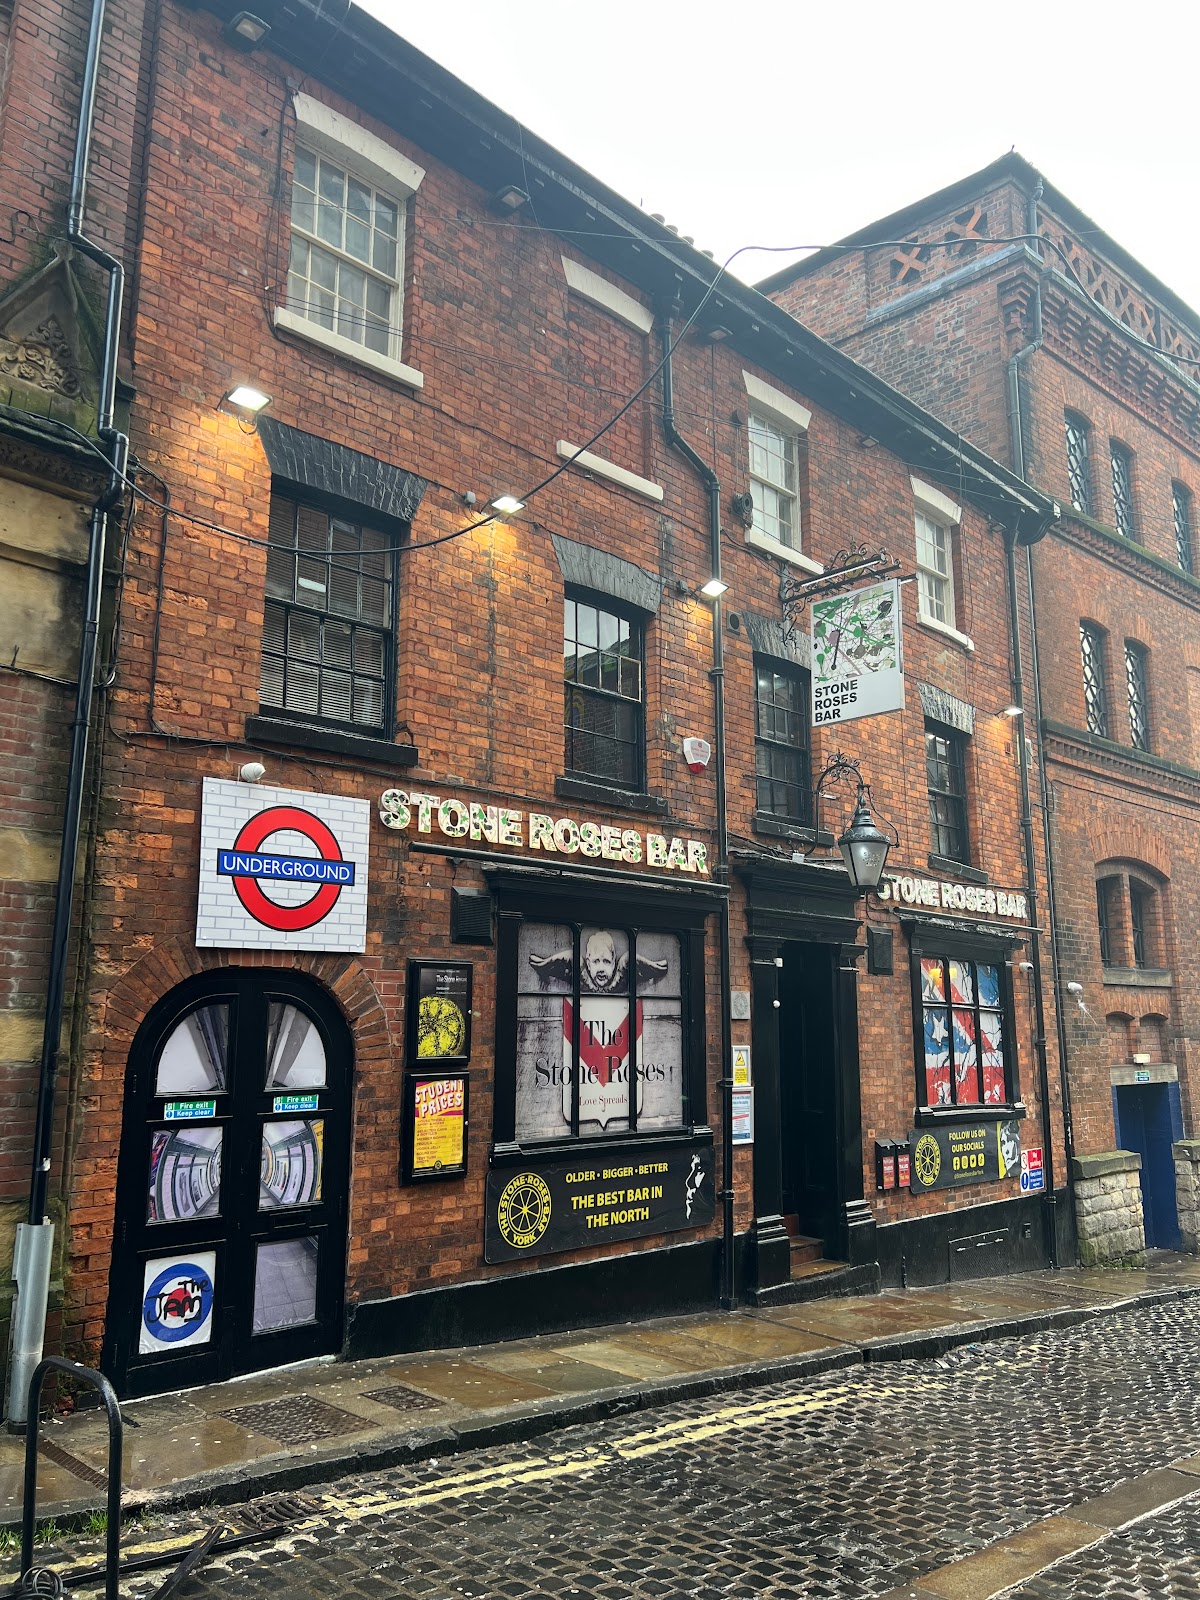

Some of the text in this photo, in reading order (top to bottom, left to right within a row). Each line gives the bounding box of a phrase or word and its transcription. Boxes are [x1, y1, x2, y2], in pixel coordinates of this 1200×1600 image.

[814, 679, 858, 698] STONE
[814, 692, 858, 711] ROSES
[814, 708, 841, 723] BAR
[379, 788, 709, 874] STONE ROSES BAR
[223, 855, 350, 881] UNDERGROUND
[877, 872, 1028, 919] STONE ROSES BAR
[583, 1020, 624, 1047] The
[535, 1055, 665, 1088] Stone Roses
[415, 1079, 465, 1104] STUDENT
[579, 1094, 628, 1109] Love Spreads
[176, 1110, 193, 1118] Keep
[195, 1101, 209, 1109] exit
[284, 1103, 299, 1111] Keep
[421, 1092, 463, 1118] PRICES
[948, 1128, 986, 1141] FOLLOW US ON
[951, 1141, 985, 1153] OUR SOCIALS
[565, 1162, 669, 1184] OLDER BIGGER BETTER
[499, 1175, 550, 1237] THE STONE ROSES BAR
[571, 1185, 663, 1210] THE BEST BAR IN
[586, 1206, 650, 1229] THE NORTH
[512, 1231, 537, 1246] YORK
[177, 1278, 212, 1295] The
